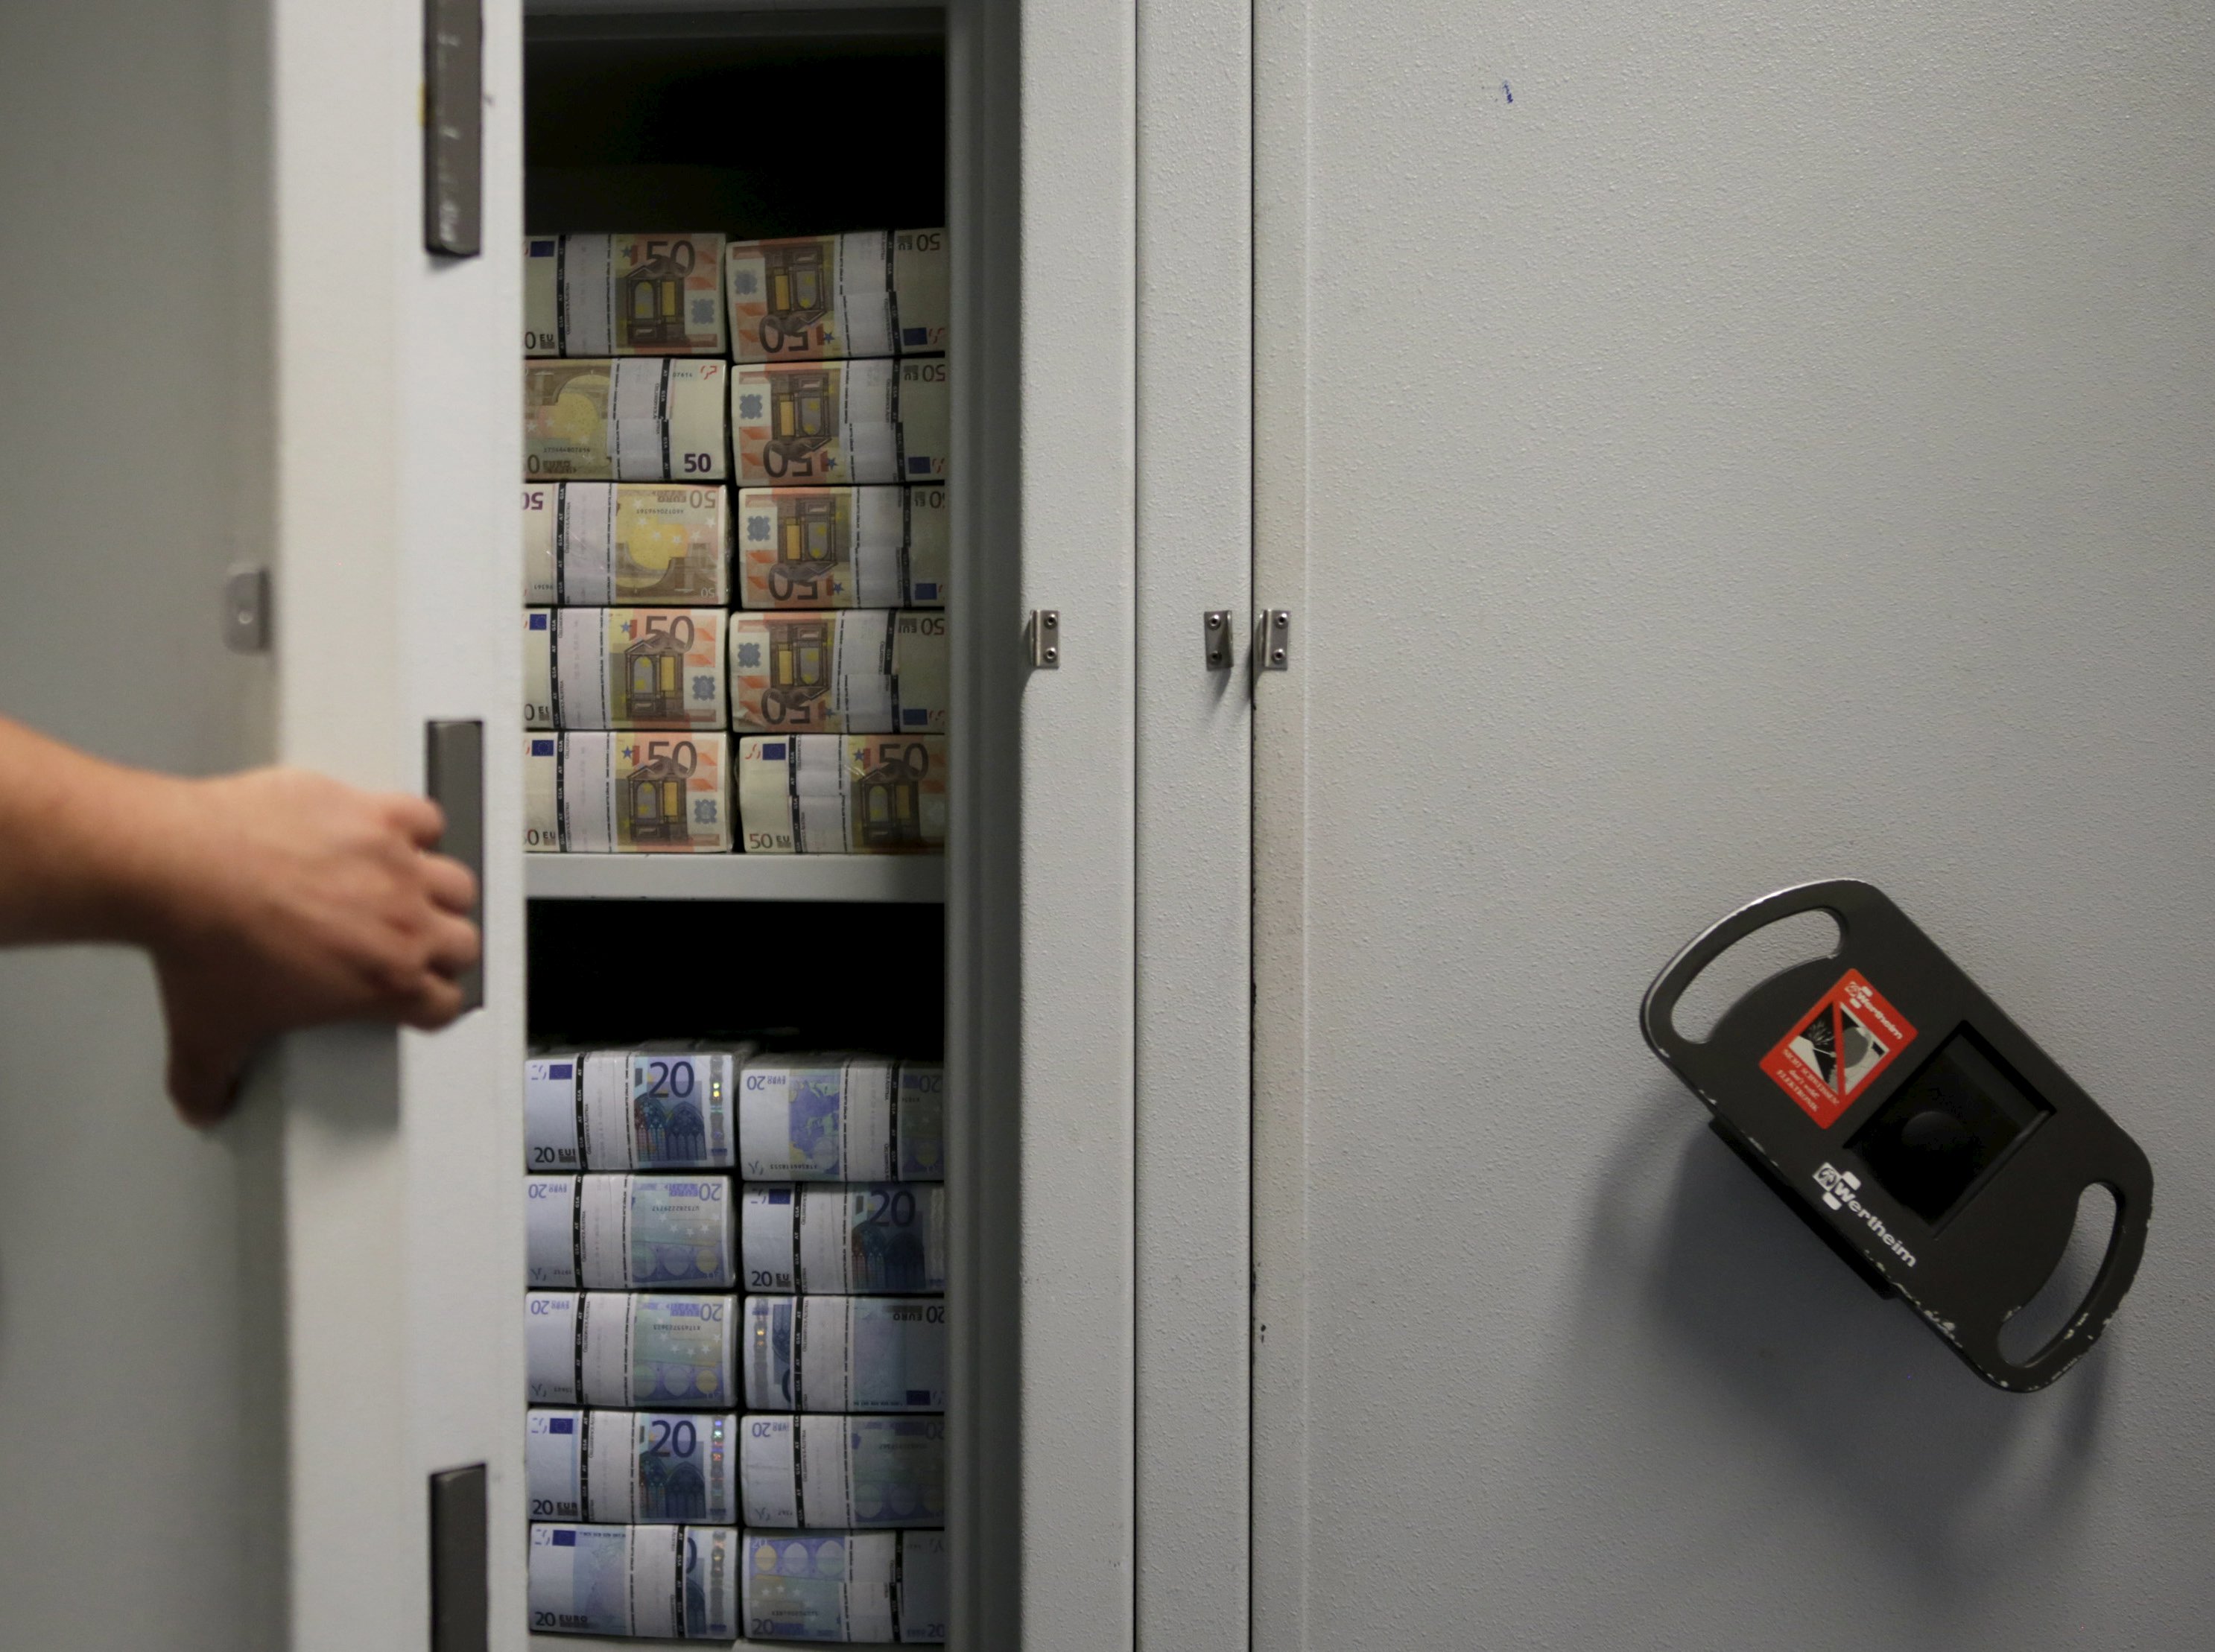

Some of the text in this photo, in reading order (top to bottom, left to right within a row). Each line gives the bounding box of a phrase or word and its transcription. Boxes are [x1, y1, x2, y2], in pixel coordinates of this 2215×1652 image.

[916, 234, 940, 251] 50
[647, 241, 695, 277] 50
[525, 331, 536, 349] 0
[759, 314, 808, 353] 50
[922, 364, 945, 381] 50
[527, 454, 539, 473] 0
[684, 453, 711, 472] 50
[764, 440, 813, 477] 50
[690, 490, 716, 509] 50
[929, 492, 945, 509] 0
[769, 564, 818, 601] 50
[701, 587, 715, 597] 50
[646, 616, 694, 652] 50
[921, 617, 945, 635] 50
[525, 704, 534, 720] 0
[761, 688, 811, 724] 50
[648, 741, 697, 778] 50
[880, 743, 928, 781] 50
[524, 830, 539, 845] 0
[750, 833, 773, 849] 50
[1857, 994, 1902, 1039] Wertheim
[650, 1061, 694, 1098] 20
[747, 1076, 766, 1090] 20
[534, 1147, 554, 1163] 20
[529, 1184, 547, 1198] 20
[699, 1183, 722, 1201] 20
[870, 1189, 916, 1227] 20
[1835, 1181, 1916, 1267] Wertheim
[752, 1271, 772, 1286] 20
[531, 1300, 549, 1315] 20
[700, 1303, 723, 1321] 20
[893, 1306, 945, 1324] 20 EURO
[651, 1420, 696, 1458] 20
[752, 1423, 771, 1437] 20
[533, 1500, 553, 1515] 20
[535, 1612, 555, 1627] 20
[752, 1618, 774, 1636] 20
[927, 1624, 945, 1638] 20
